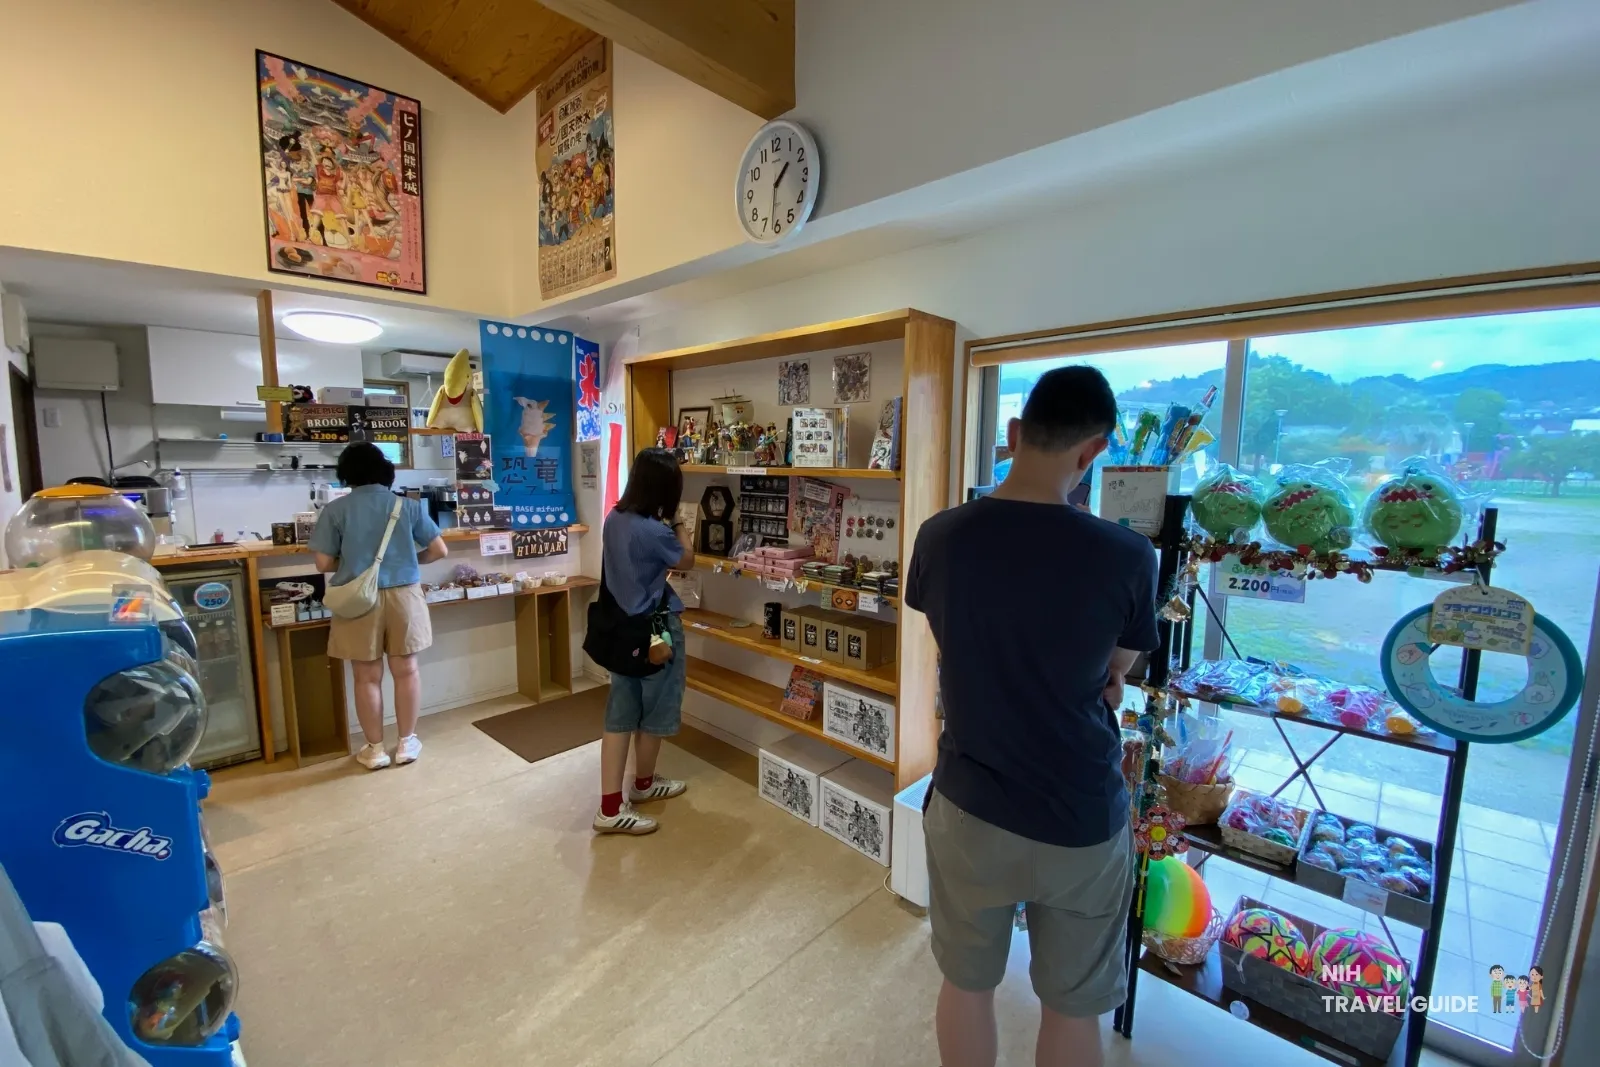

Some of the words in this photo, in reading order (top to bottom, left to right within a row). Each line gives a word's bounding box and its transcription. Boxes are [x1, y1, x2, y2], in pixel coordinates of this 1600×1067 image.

[549, 109, 591, 147] ヒノ国天然水
[771, 137, 781, 153] 12
[788, 137, 792, 152] 1
[403, 113, 419, 195] ヒノ国熊本城
[760, 148, 767, 164] 11
[797, 147, 805, 162] 2
[750, 166, 760, 182] 10
[802, 167, 809, 182] 3
[747, 189, 754, 204] 9
[796, 190, 804, 204] 4
[752, 207, 759, 222] 8
[786, 208, 795, 224] 5
[761, 217, 768, 232] 7
[774, 219, 781, 234] 6
[307, 417, 346, 428] BROOK
[371, 419, 407, 429] BROOK
[501, 457, 559, 483] 恐竜
[536, 505, 564, 513] mifune
[516, 541, 567, 557] HIMAWARI
